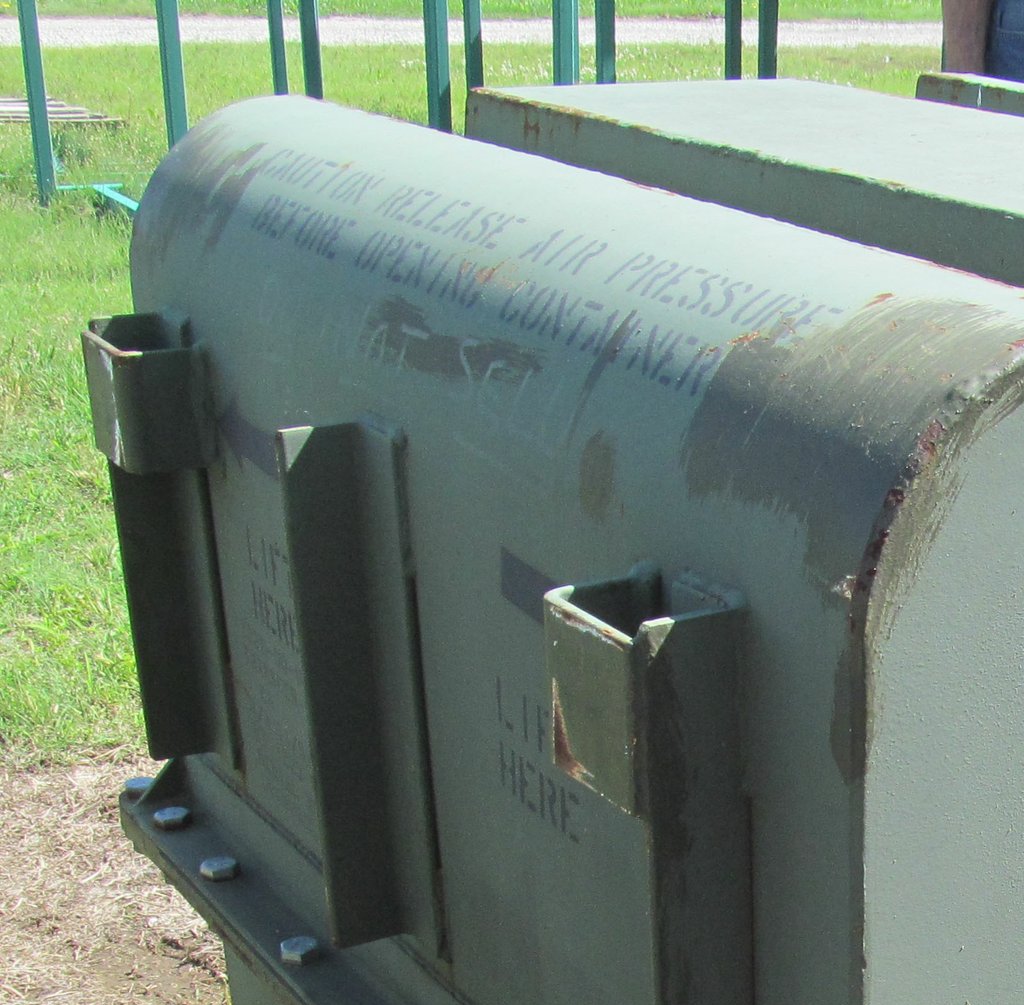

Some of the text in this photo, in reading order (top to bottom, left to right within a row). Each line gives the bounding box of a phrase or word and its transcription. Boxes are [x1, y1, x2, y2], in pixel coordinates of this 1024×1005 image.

[250, 193, 358, 260] BEFORE
[353, 229, 483, 309] OPENING
[258, 148, 386, 205] CAUTION
[374, 185, 528, 250] RELEASE
[518, 229, 609, 276] AIR
[499, 740, 581, 844] HERE
